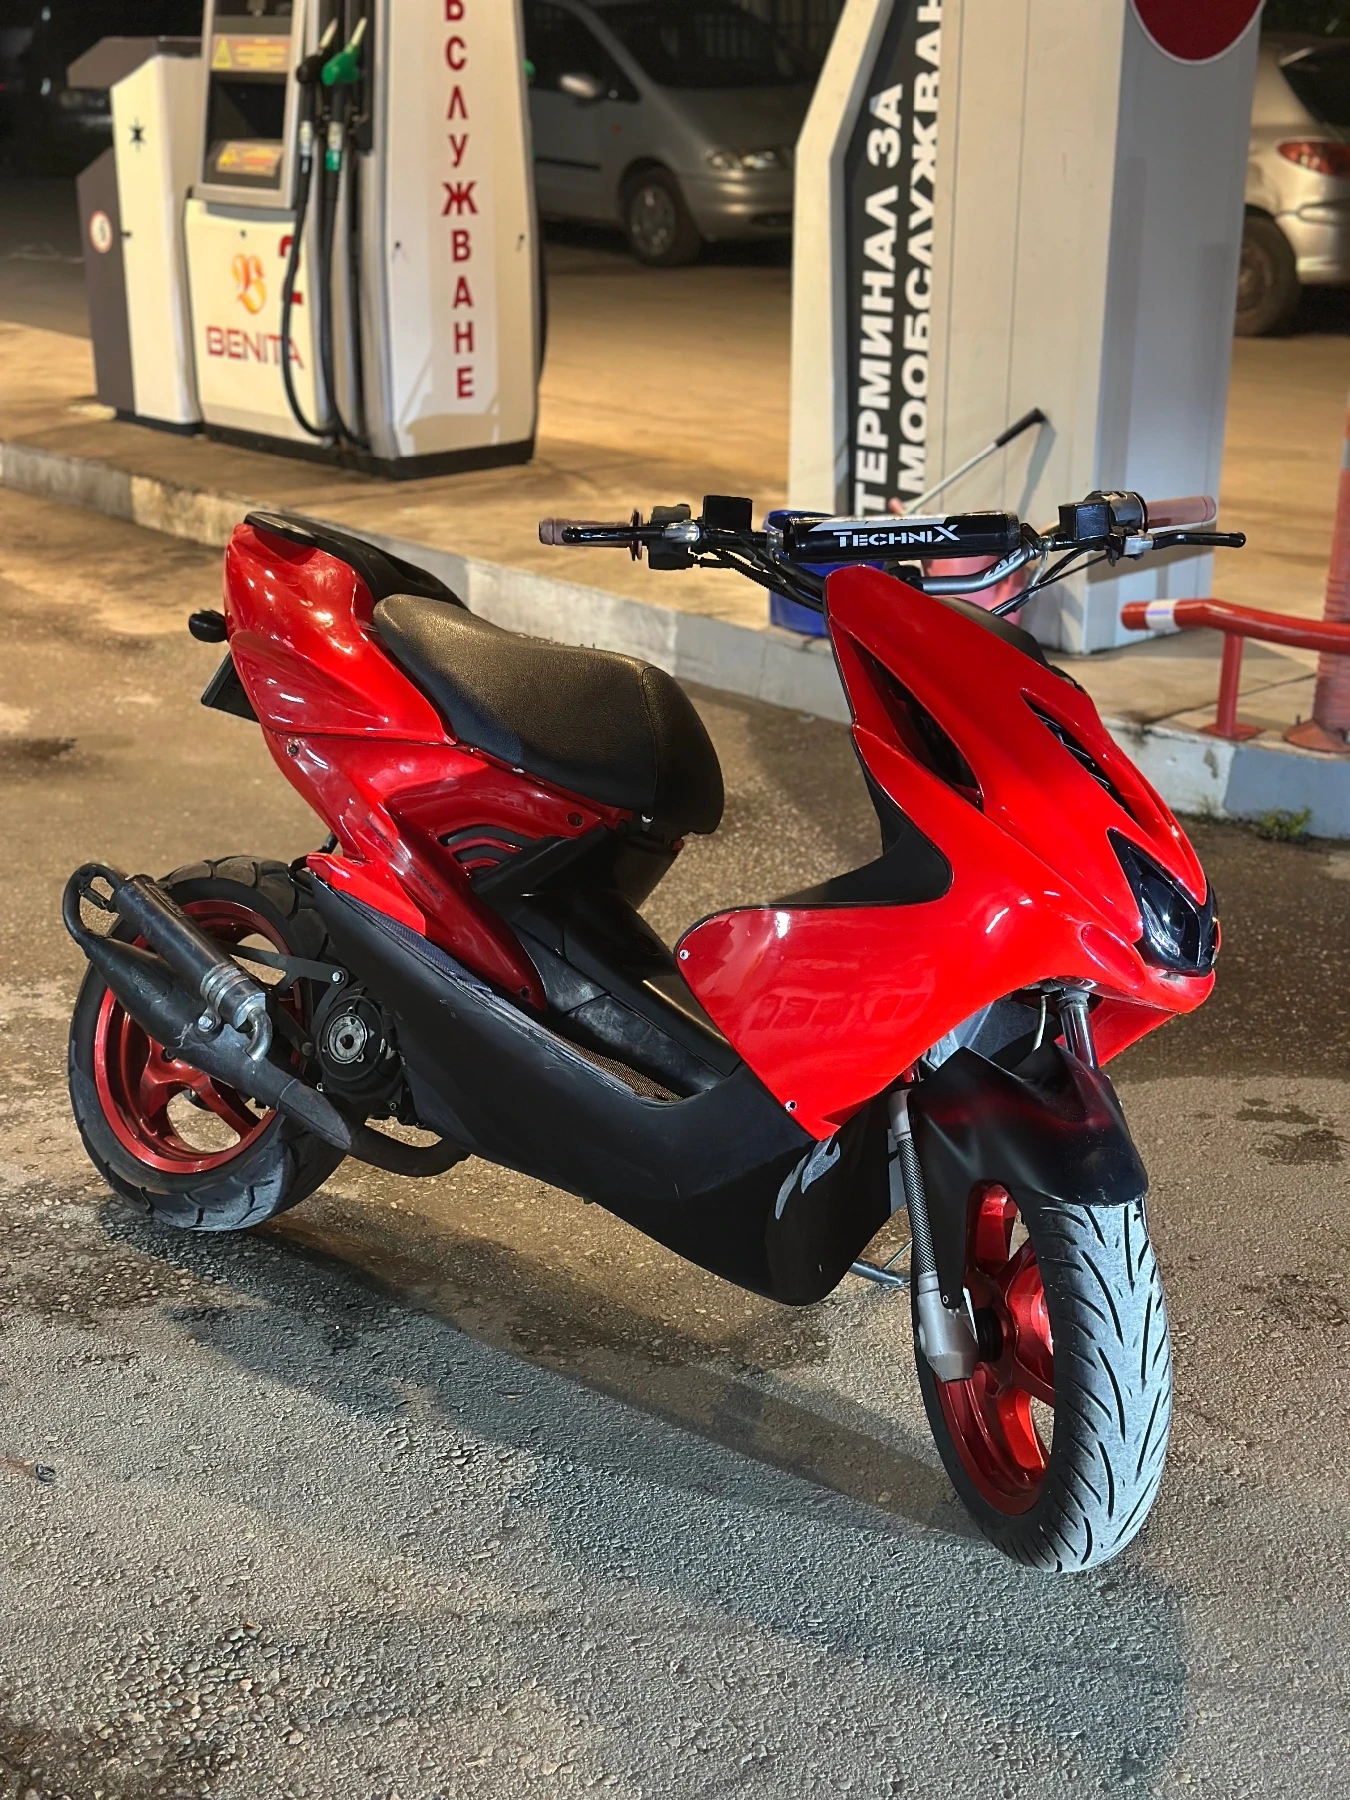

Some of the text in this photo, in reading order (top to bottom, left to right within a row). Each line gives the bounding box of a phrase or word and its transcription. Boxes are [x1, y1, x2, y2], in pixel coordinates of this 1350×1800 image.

[206, 325, 305, 370] BENITA
[854, 83, 903, 518] ТЕРМИНАЛ ЗА
